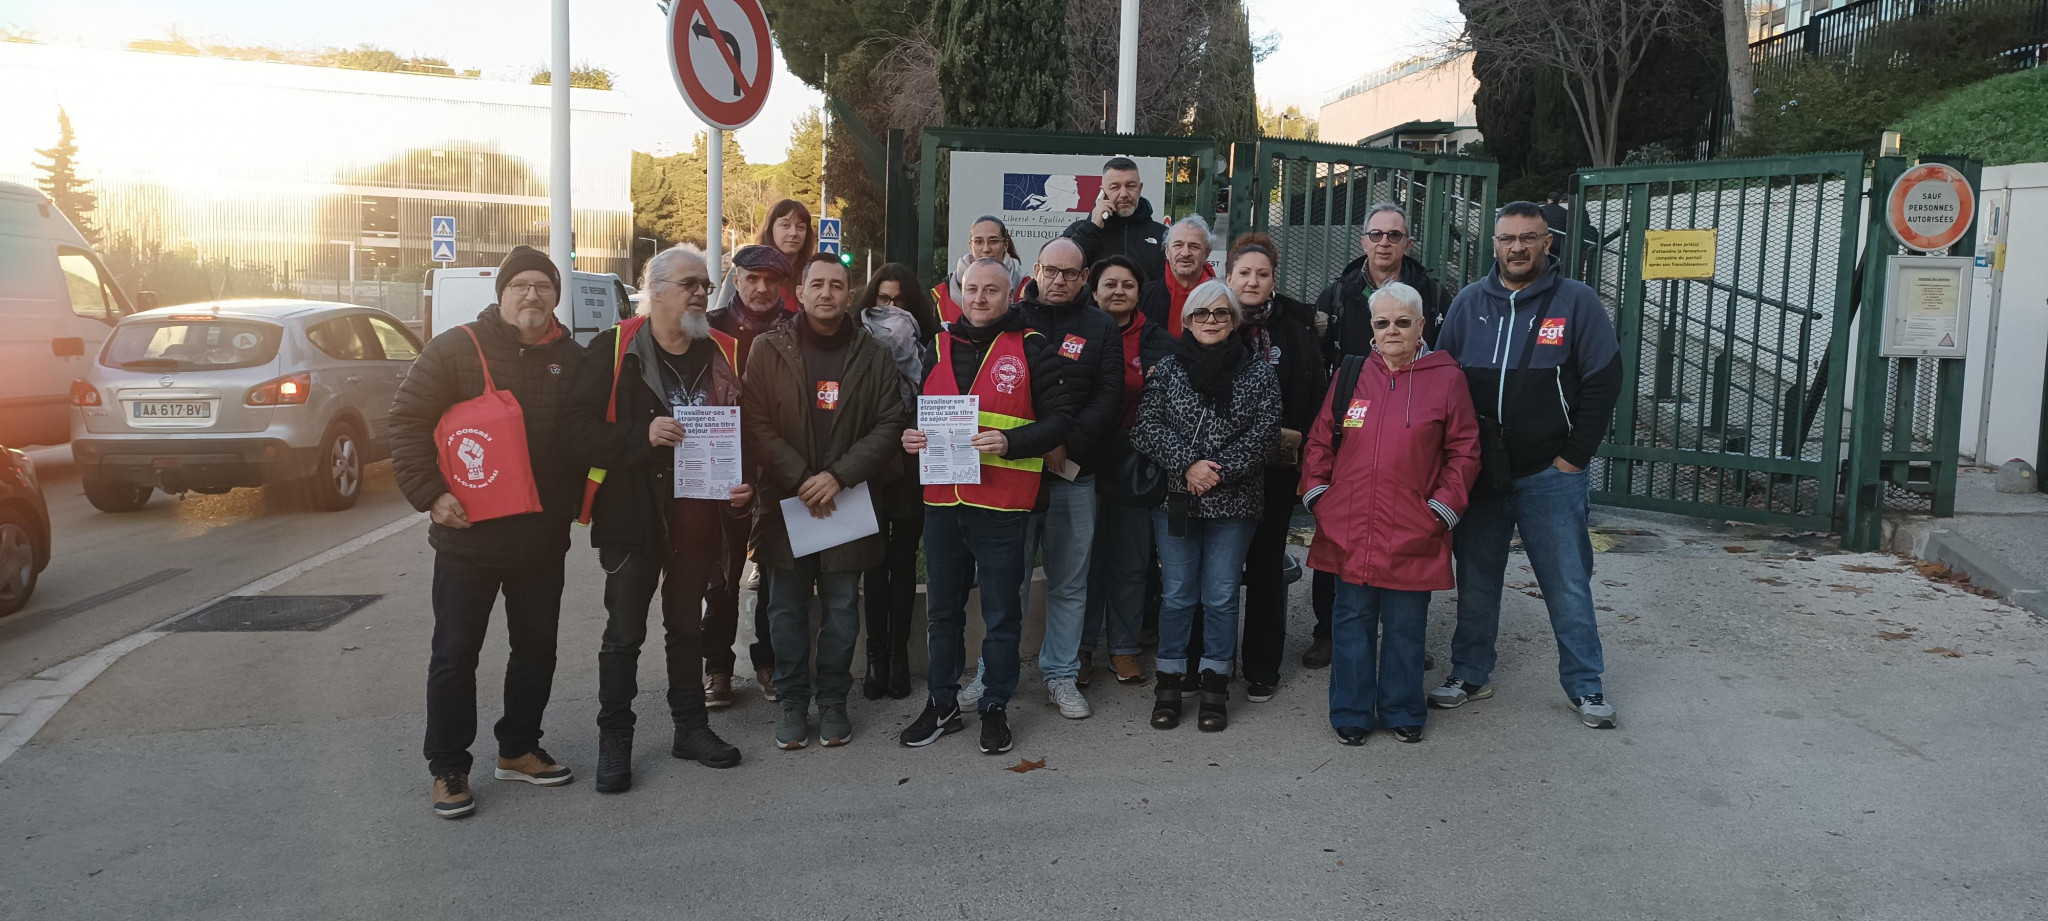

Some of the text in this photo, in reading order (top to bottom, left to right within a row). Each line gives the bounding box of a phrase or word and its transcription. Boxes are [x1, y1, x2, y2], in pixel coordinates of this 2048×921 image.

[1908, 214, 1954, 222] AUTORISÉES
[1538, 325, 1565, 340] cgt
[1062, 342, 1084, 354] cgt
[818, 390, 838, 404] cgt
[1348, 406, 1368, 419] cgt
[468, 464, 483, 476] cgt
